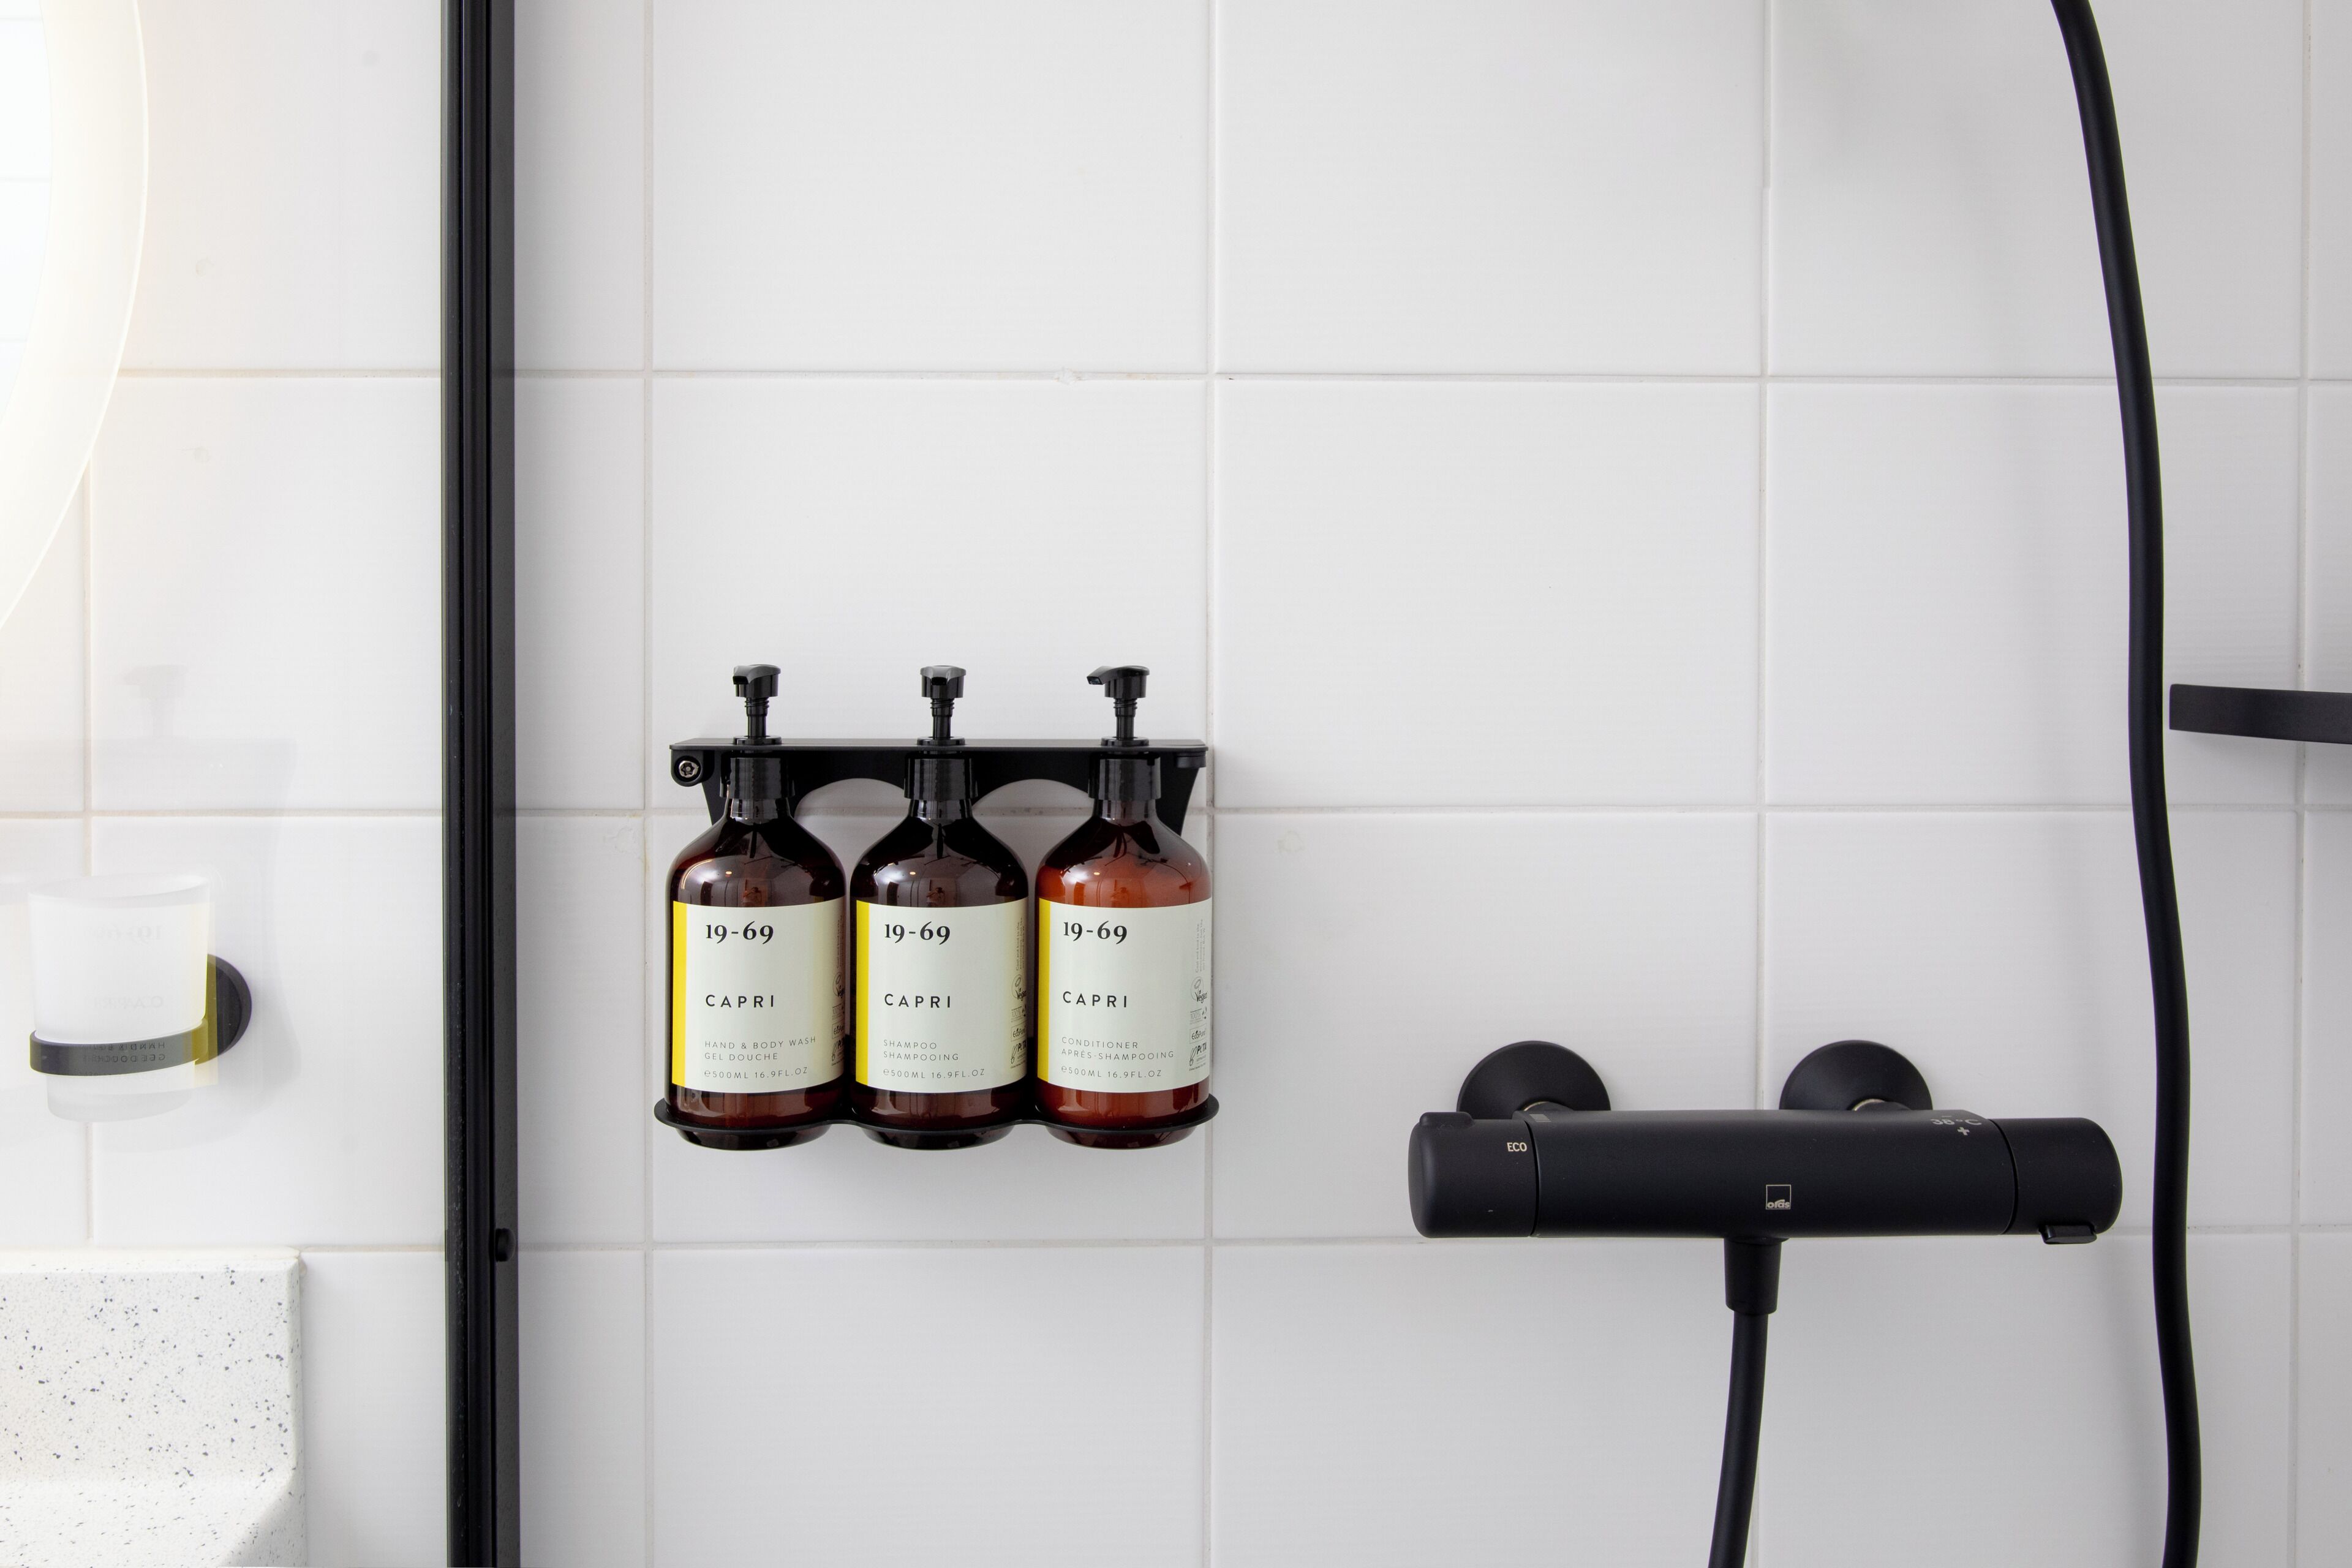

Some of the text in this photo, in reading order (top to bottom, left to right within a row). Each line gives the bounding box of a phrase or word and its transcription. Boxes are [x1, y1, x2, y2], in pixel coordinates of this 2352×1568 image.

[706, 921, 774, 944] 19-69
[885, 921, 950, 945] 19-69
[1063, 920, 1128, 944] 19-69
[706, 994, 774, 1008] CAPRI
[884, 993, 951, 1008] CAPRI
[1063, 991, 1128, 1008] CAPRI
[705, 1041, 735, 1049] HAND
[753, 1041, 784, 1049] BODY
[789, 1036, 816, 1047] WASH
[883, 1039, 937, 1050] SHAMPOO
[1061, 1036, 1138, 1049] CONDITIONER
[704, 1052, 778, 1061] GEL DOUCHE
[883, 1051, 959, 1061] SHAMPOOING
[1061, 1049, 1174, 1061] APRÈS-SHAMPOOING
[754, 1067, 808, 1079] 16.9FL.OZ
[932, 1069, 985, 1079] 16.9FL.OZ
[1107, 1069, 1162, 1079] 16.9FL.OZ
[1506, 1142, 1528, 1152] ECO
[1766, 1199, 1790, 1208] oras
